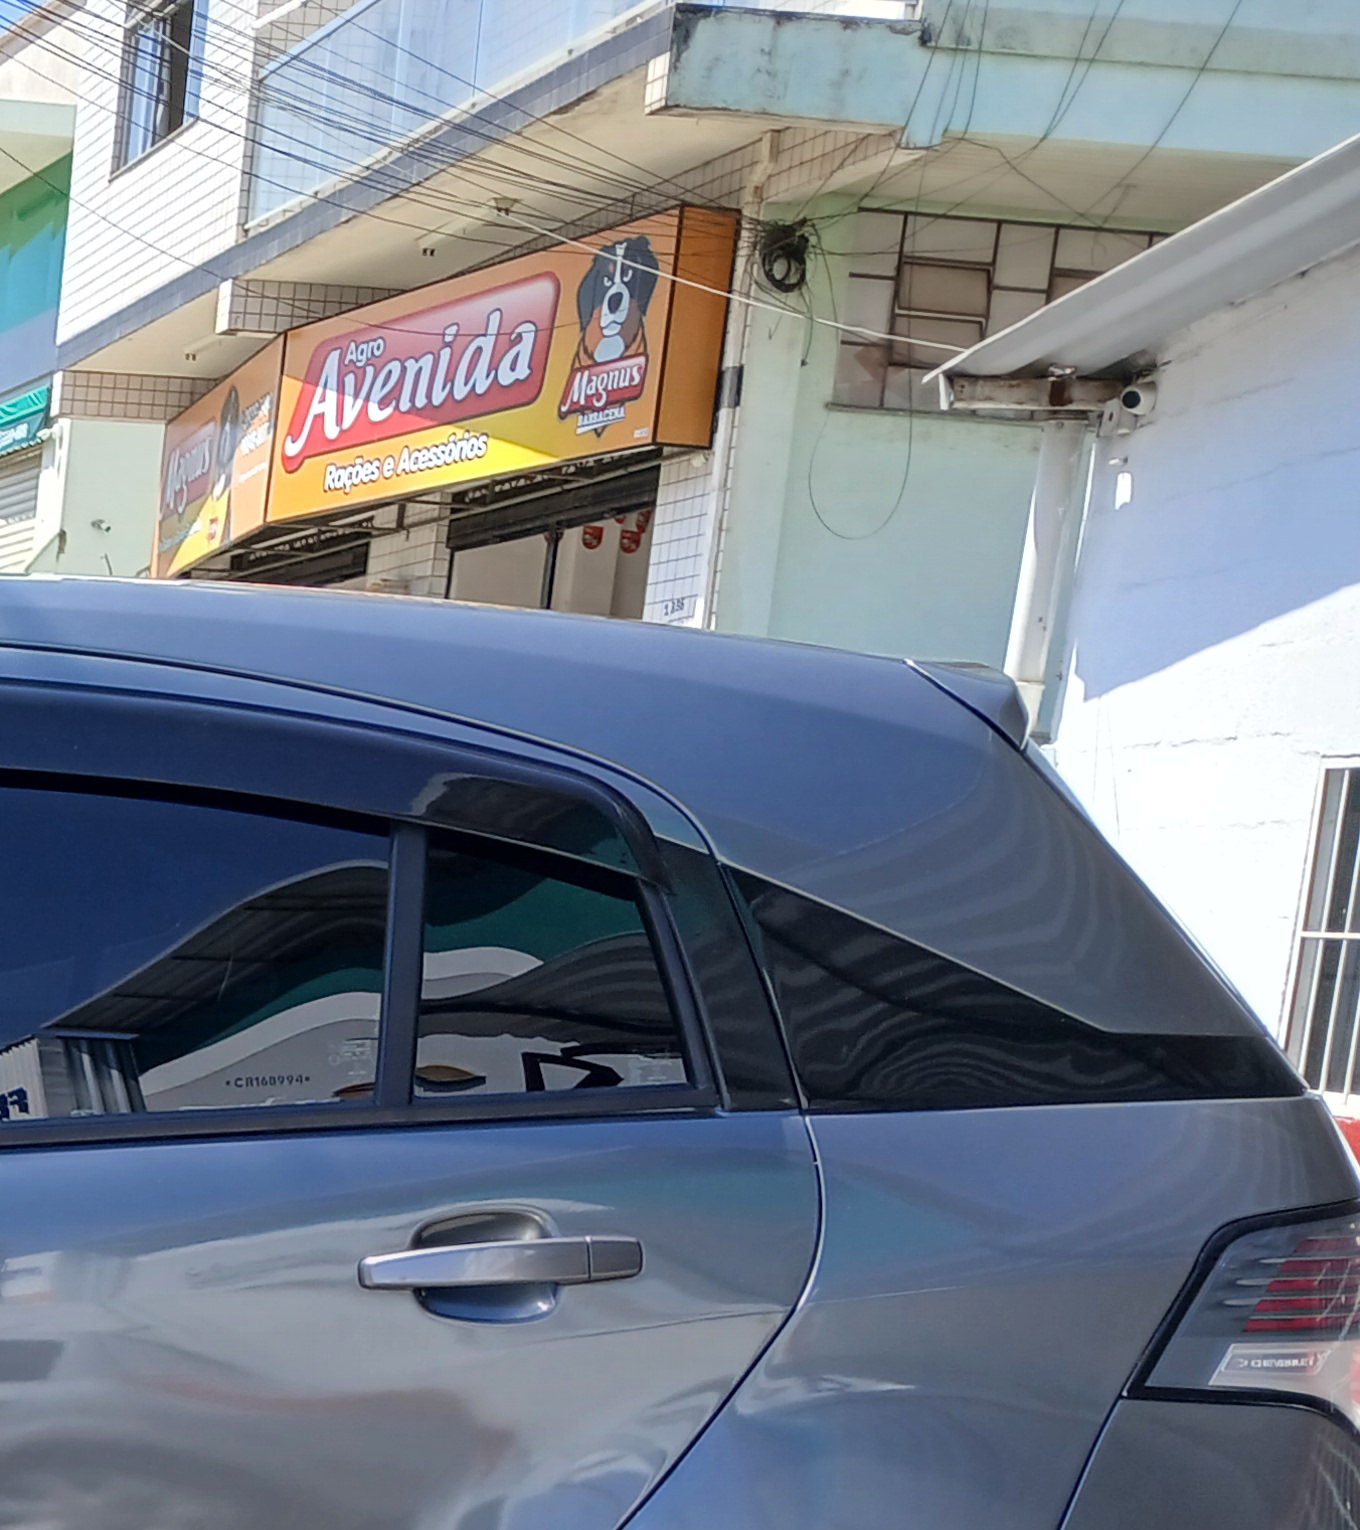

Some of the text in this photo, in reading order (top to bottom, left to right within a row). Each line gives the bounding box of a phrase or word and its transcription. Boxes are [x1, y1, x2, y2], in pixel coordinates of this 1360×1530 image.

[343, 336, 386, 368] Agro
[284, 307, 539, 458] Avenida
[560, 364, 643, 411] Magnus
[323, 430, 490, 494] Rações e Acessórios
